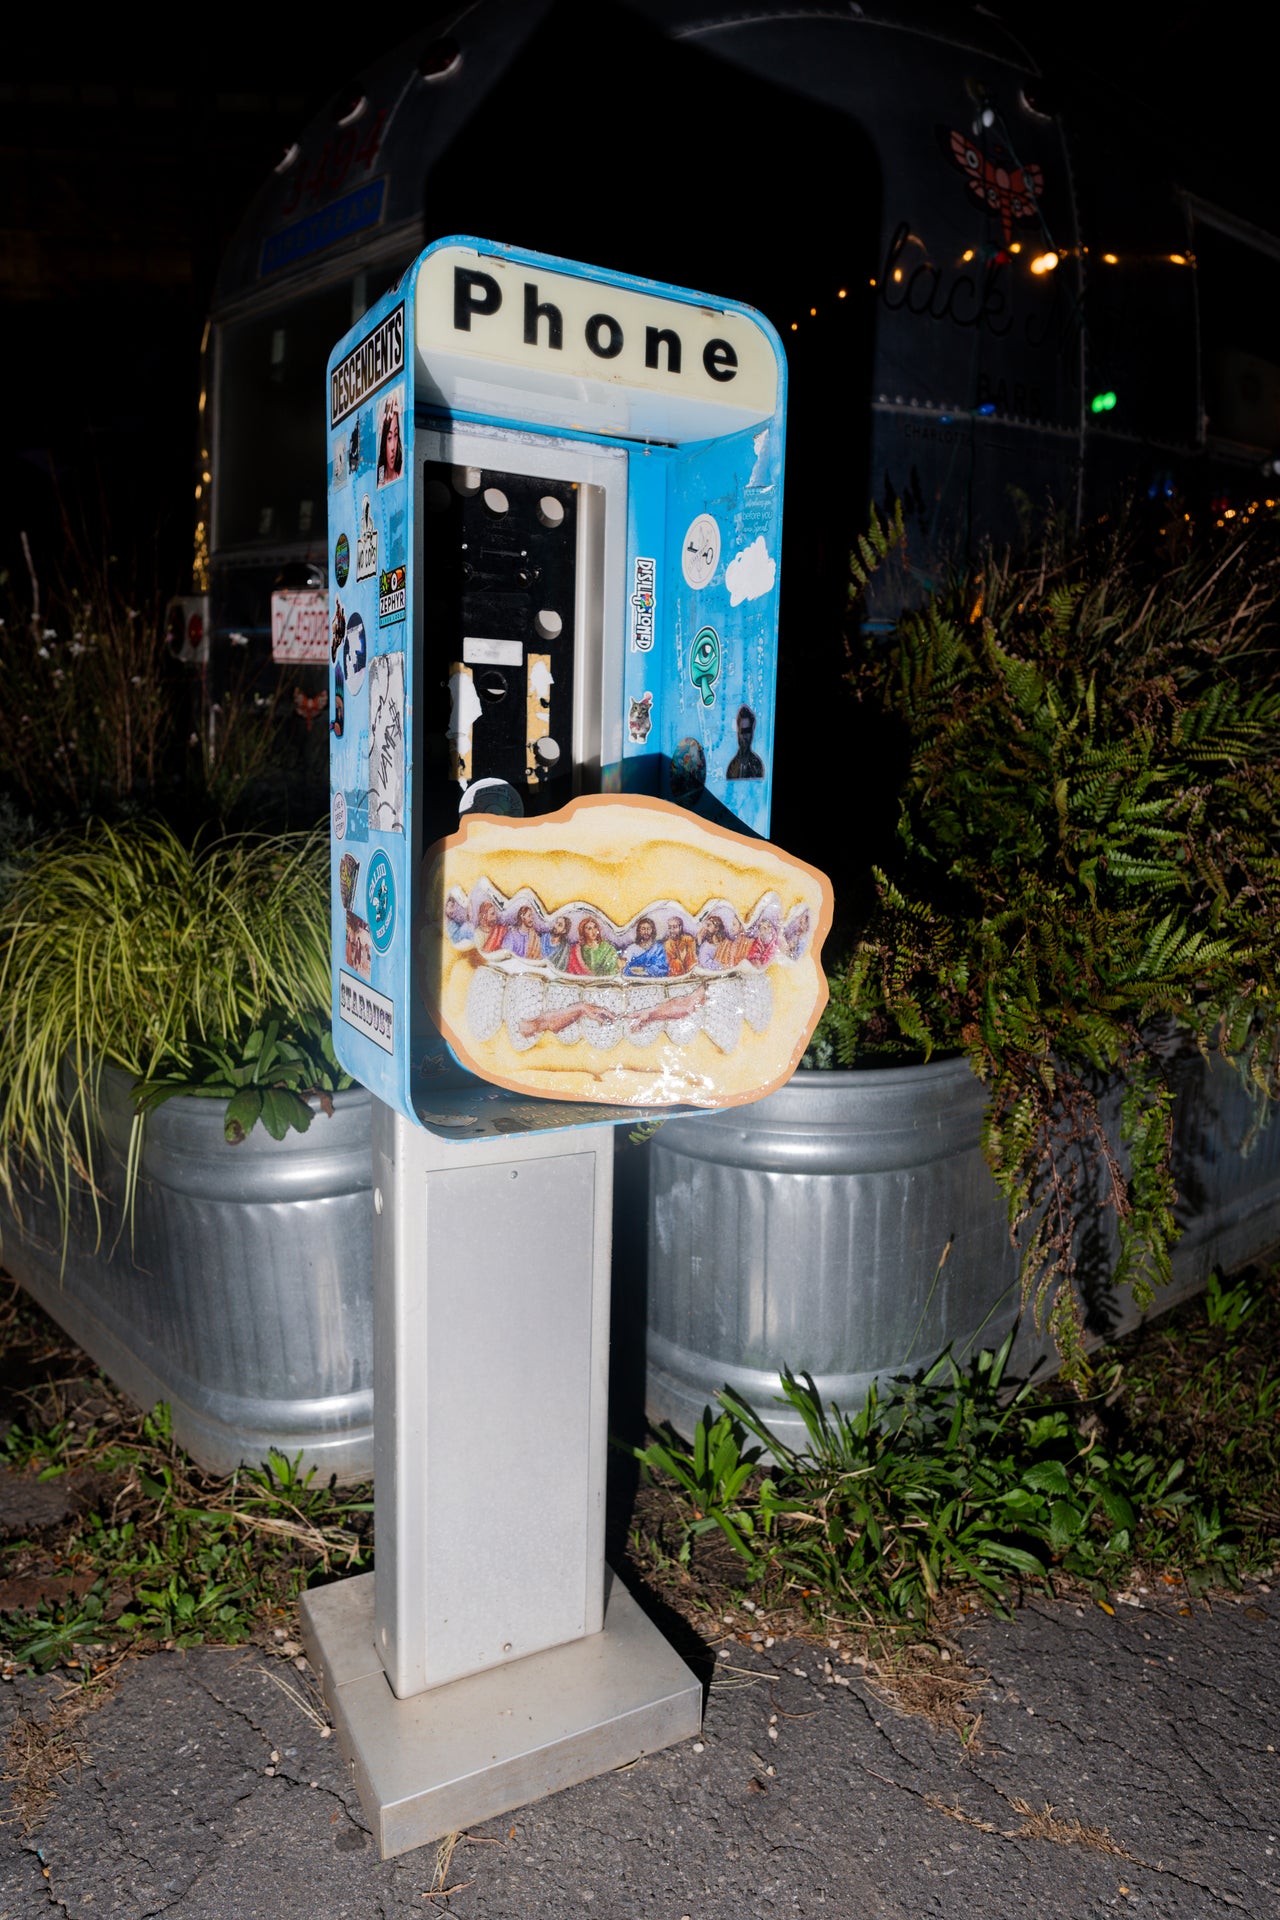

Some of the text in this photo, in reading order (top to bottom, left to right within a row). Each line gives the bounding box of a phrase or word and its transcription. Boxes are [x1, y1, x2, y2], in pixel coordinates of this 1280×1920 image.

[453, 266, 738, 382] Phone
[880, 220, 1014, 336] lack
[332, 311, 402, 420] DESCENDENTS
[380, 591, 405, 615] ZEPHYR
[340, 983, 392, 1040] STARDUST
